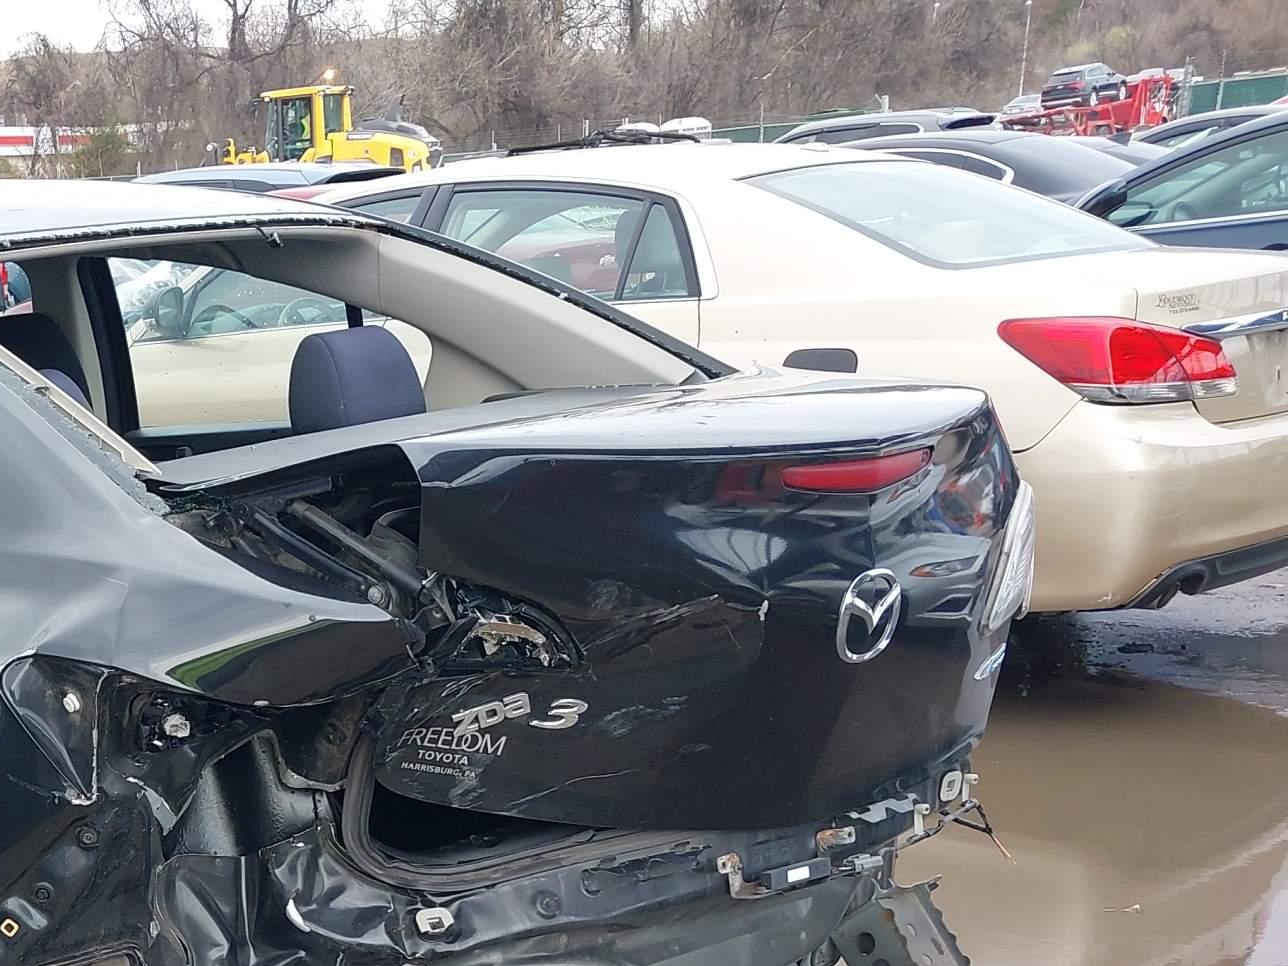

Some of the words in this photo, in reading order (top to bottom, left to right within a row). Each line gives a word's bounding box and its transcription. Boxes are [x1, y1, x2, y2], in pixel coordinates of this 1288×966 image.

[528, 698, 589, 730] 3
[396, 727, 508, 756] FREEDOM
[417, 749, 469, 766] TOYOTA
[400, 761, 463, 777] HARRISBURG,
[464, 770, 477, 779] PA
